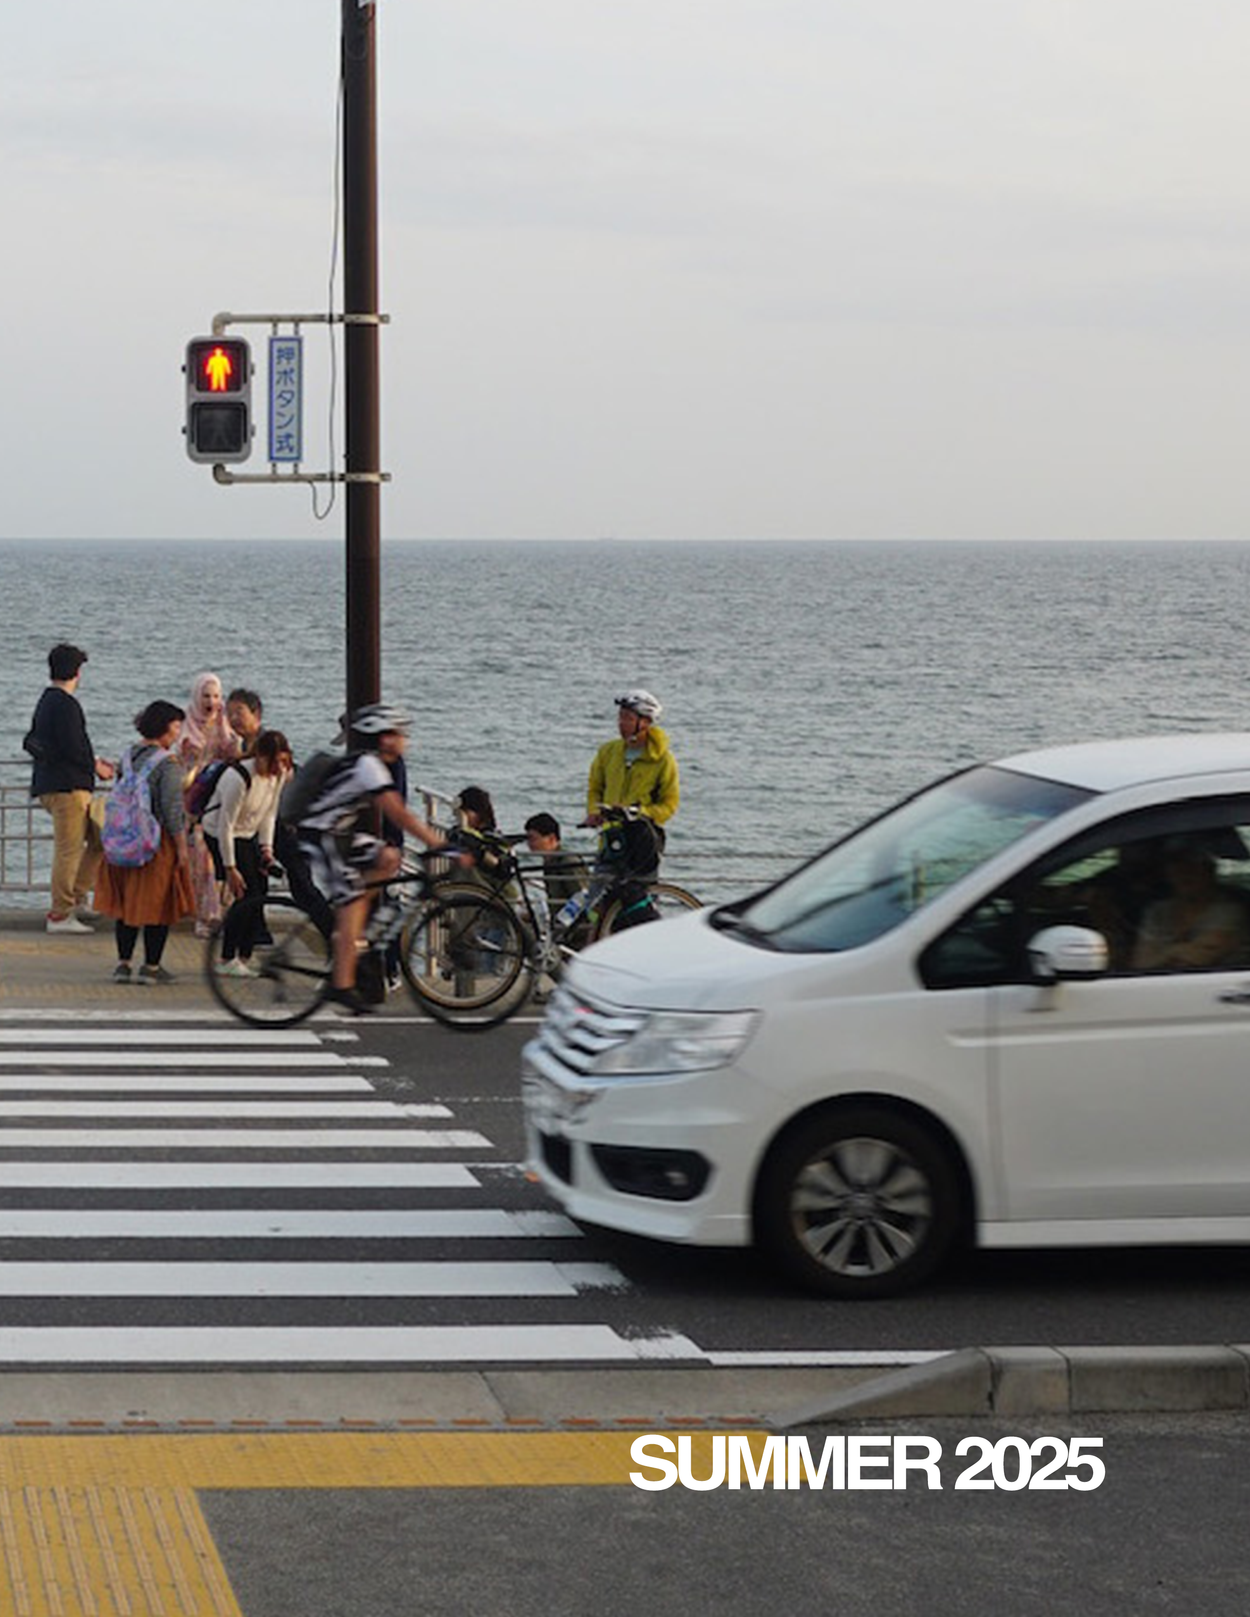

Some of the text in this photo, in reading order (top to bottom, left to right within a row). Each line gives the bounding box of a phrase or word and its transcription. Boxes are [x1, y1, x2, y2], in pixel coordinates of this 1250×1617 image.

[276, 346, 296, 453] 押ボタン式
